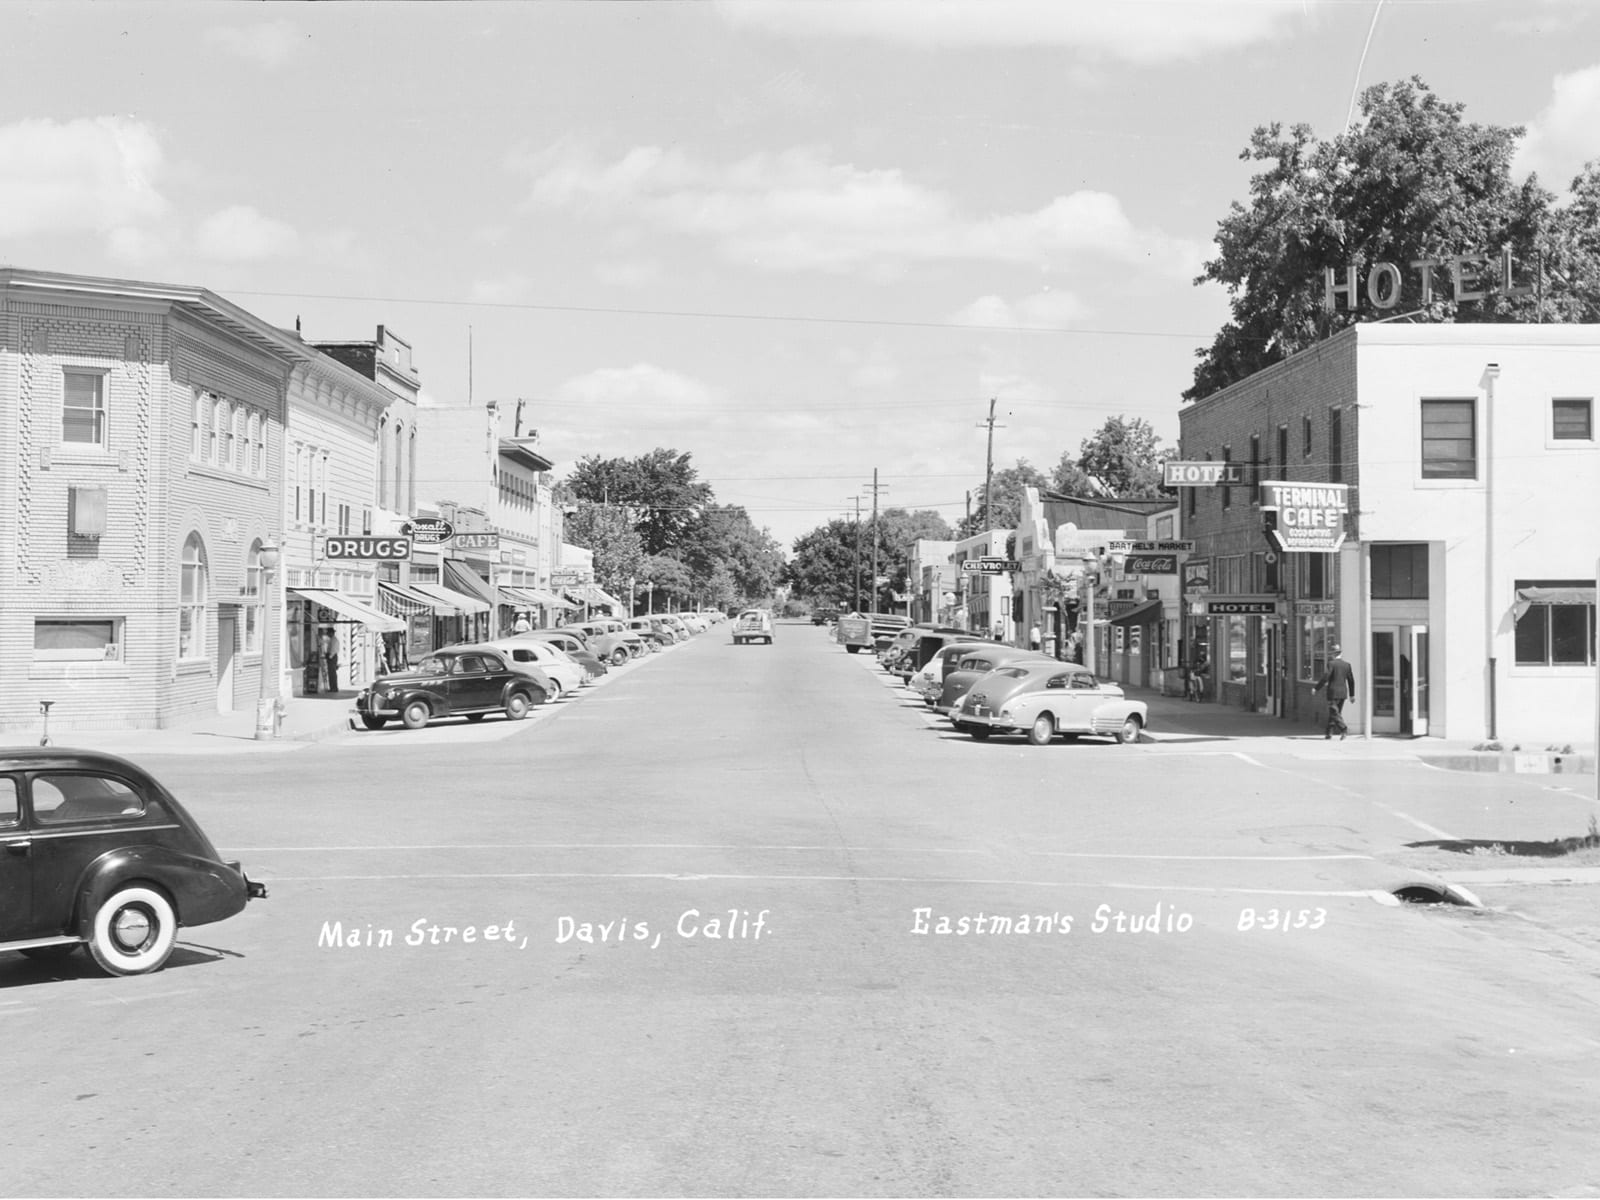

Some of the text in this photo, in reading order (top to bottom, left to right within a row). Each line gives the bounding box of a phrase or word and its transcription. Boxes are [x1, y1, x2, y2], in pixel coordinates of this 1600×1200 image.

[1325, 244, 1534, 312] HOTEL
[1170, 466, 1240, 482] HOTEL
[1272, 487, 1346, 508] TERMINAL
[1283, 508, 1339, 527] CAFE
[327, 540, 407, 557] DRUGS
[455, 535, 497, 548] CAFE
[1158, 542, 1193, 551] MARKET
[965, 561, 1018, 570] CHEVROLET
[1212, 604, 1273, 613] HOTEL
